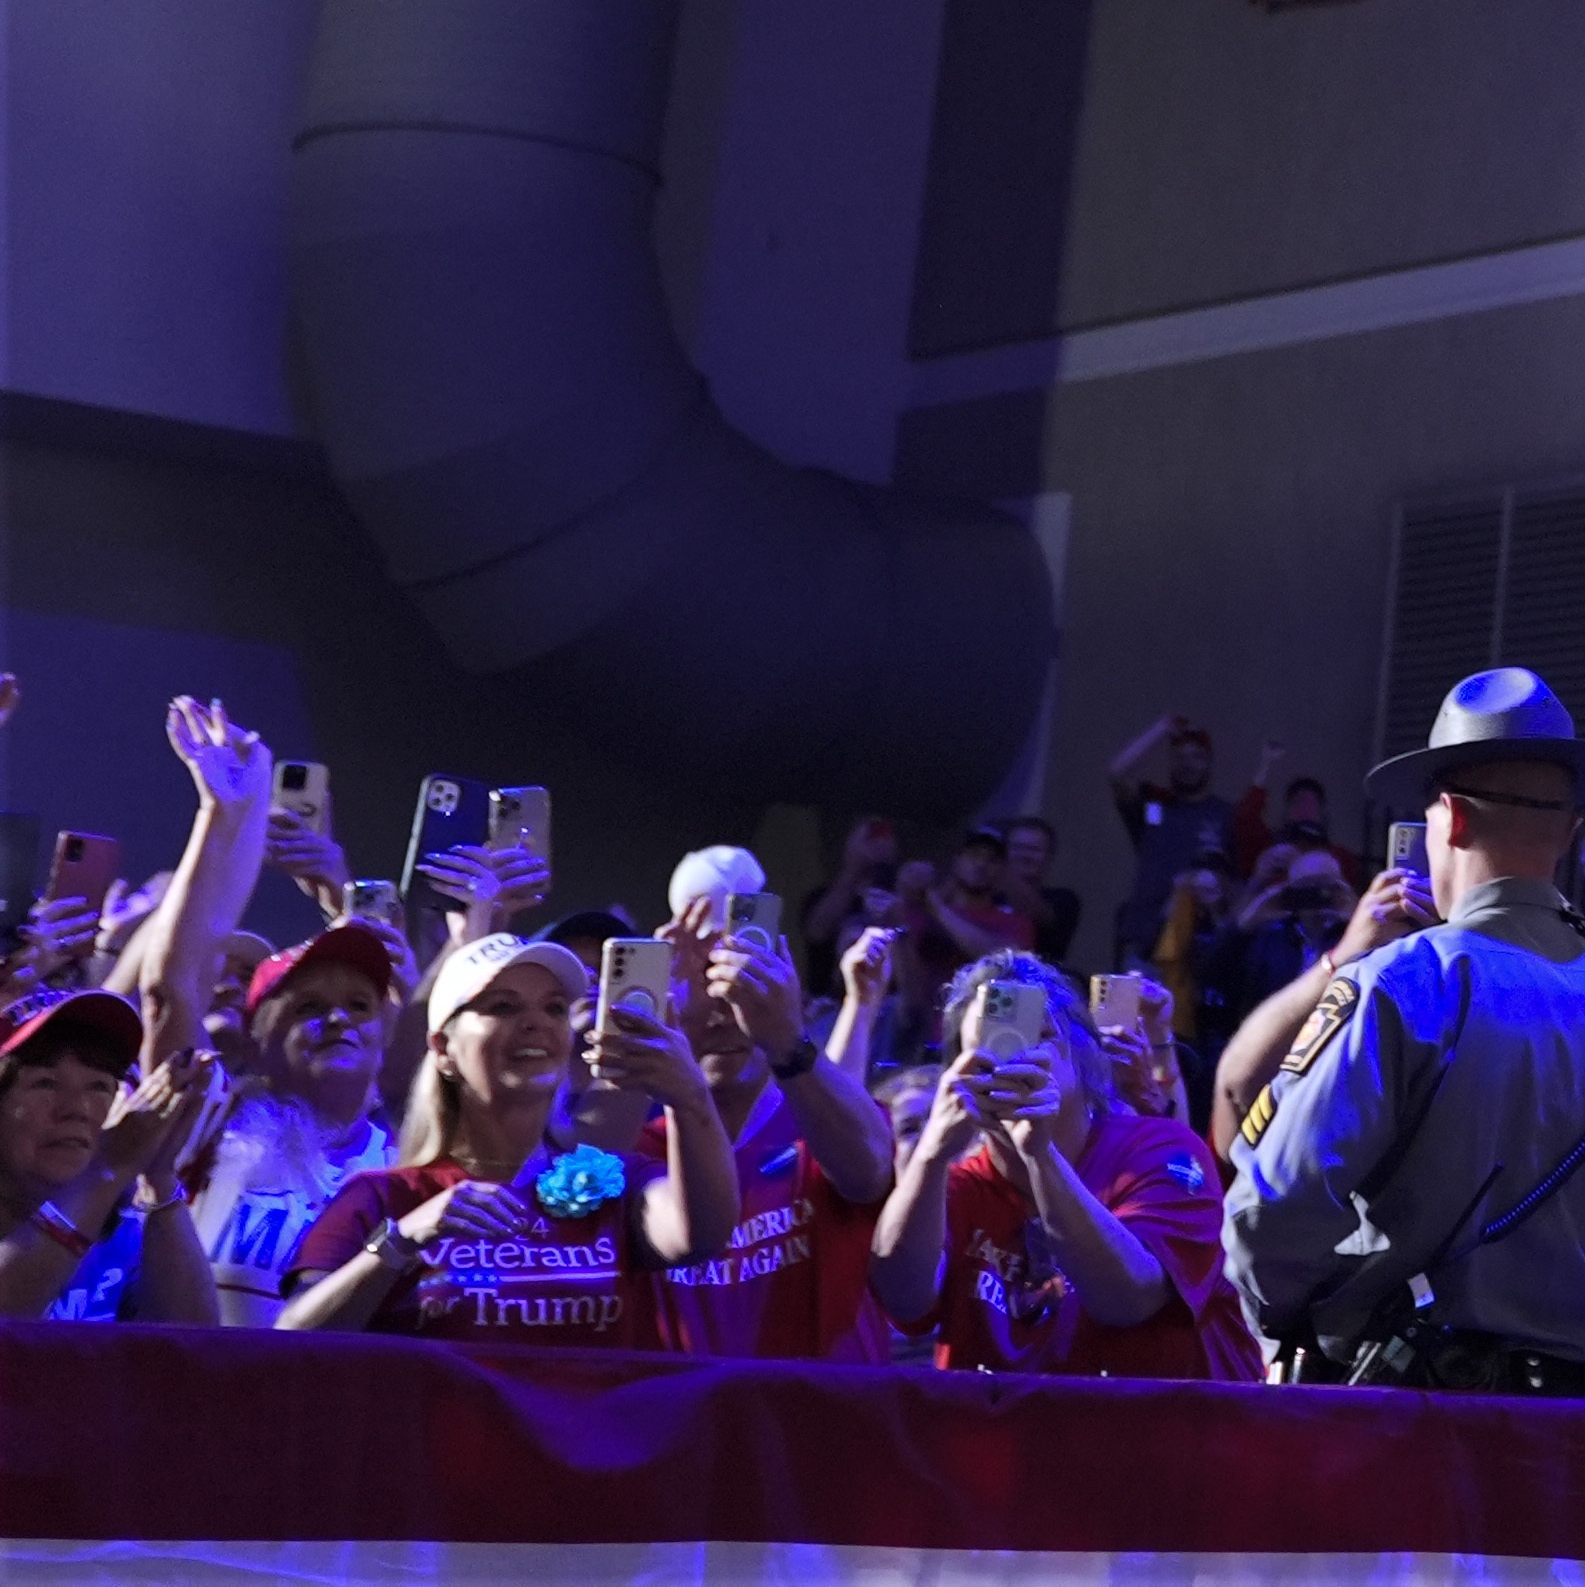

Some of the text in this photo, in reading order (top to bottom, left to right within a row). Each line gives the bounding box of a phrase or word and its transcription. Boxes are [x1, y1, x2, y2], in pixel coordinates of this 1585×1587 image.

[417, 1236, 617, 1270] Veterans
[666, 1235, 812, 1288] REAT AGAIN
[463, 1287, 624, 1331] Trump
